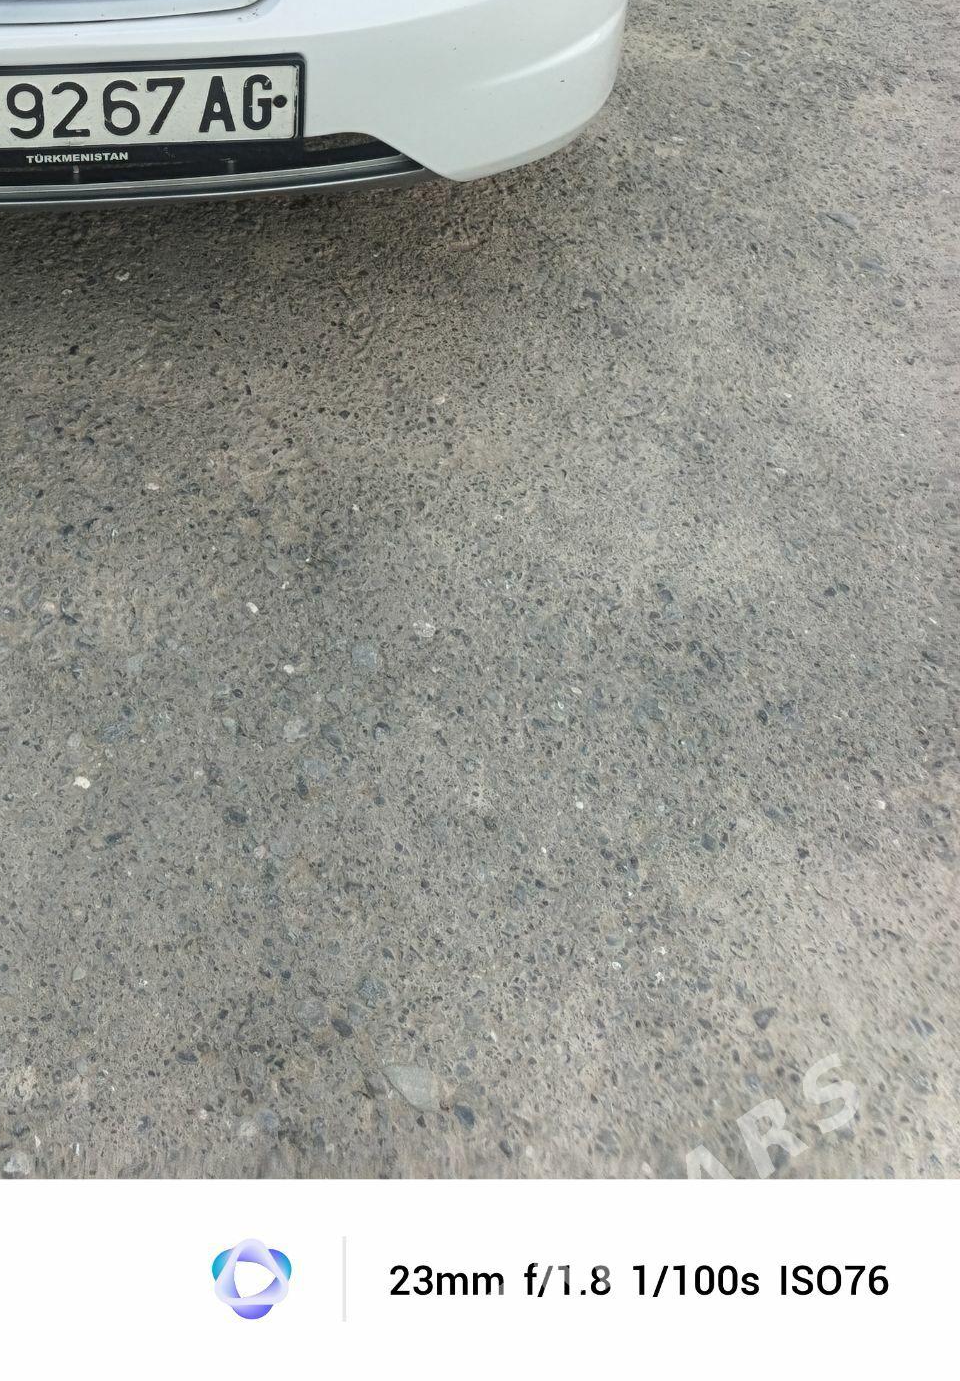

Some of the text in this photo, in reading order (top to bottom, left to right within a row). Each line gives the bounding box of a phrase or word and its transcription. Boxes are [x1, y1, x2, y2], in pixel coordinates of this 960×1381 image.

[6, 76, 186, 139] 9267
[198, 73, 273, 132] AG
[26, 151, 129, 164] TÜRKMENISTAN
